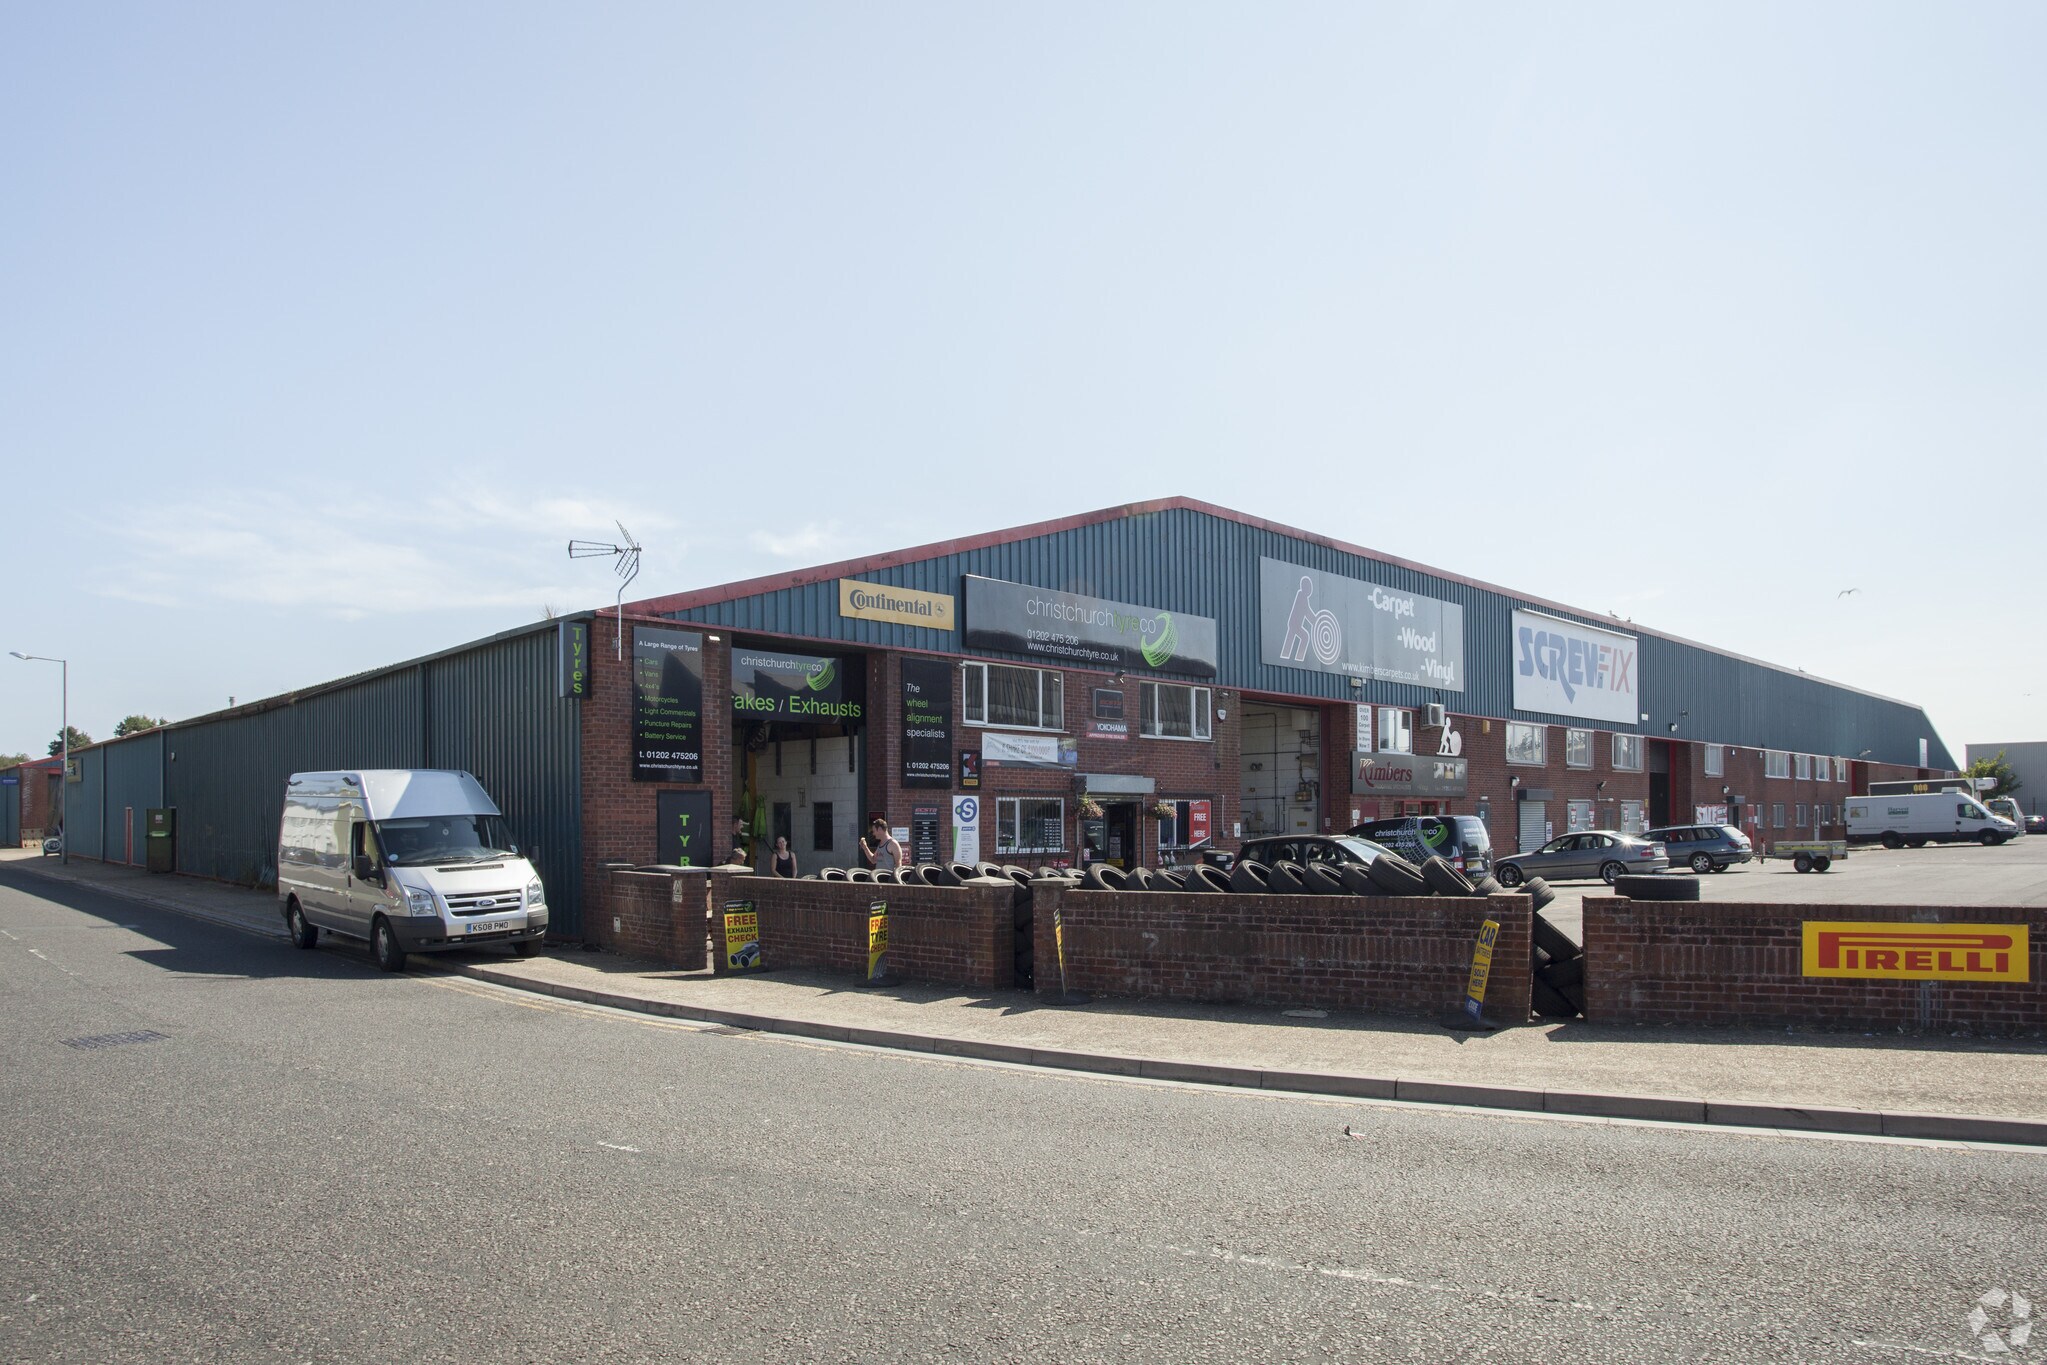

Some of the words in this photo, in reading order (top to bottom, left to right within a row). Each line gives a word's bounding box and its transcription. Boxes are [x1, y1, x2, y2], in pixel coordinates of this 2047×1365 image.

[849, 589, 932, 616] Continental
[1026, 596, 1156, 634] christchurchtyreco
[1026, 628, 1049, 641] 01202
[1051, 632, 1065, 644] 475
[1065, 634, 1079, 646] 206
[644, 641, 659, 649] Large
[660, 642, 677, 650] Range
[684, 644, 698, 652] Tyres
[1026, 641, 1119, 662] www.christchurchtyre.co.uk
[572, 627, 583, 693] Tyres
[740, 656, 822, 672] christchurchtyreco
[1518, 626, 1634, 704] SCREWFIX
[644, 670, 659, 678] Vans
[1341, 661, 1420, 681] www.kimberscarpets.co.uk
[906, 683, 920, 693] The
[644, 695, 679, 704] Motorcycles
[731, 692, 775, 712] akes
[778, 699, 784, 713] /
[789, 695, 861, 718] Exhausts
[906, 699, 928, 708] wheel
[644, 707, 659, 715] Light
[659, 708, 696, 717] Commercials
[906, 713, 943, 724] alignment
[670, 721, 692, 729] Repairs
[1096, 722, 1128, 733] YOKOHAMA
[644, 731, 665, 740] Battery
[665, 732, 686, 740] Service
[906, 729, 945, 739] specialists
[639, 750, 644, 758] t.
[646, 751, 670, 759] 01202
[671, 752, 698, 760] 475206
[911, 762, 929, 770] 01202
[929, 762, 950, 770] 475206
[1358, 758, 1413, 788] Kimbers
[1193, 812, 1207, 821] FREE
[1193, 829, 1206, 838] HERE
[726, 914, 757, 926] FREE
[870, 917, 888, 931] FREE
[727, 926, 757, 934] EXHAUST
[727, 933, 757, 943] CHECK
[870, 929, 888, 943] TYRE
[1479, 925, 1496, 948] CAR
[1818, 932, 2013, 973] PIRELLI
